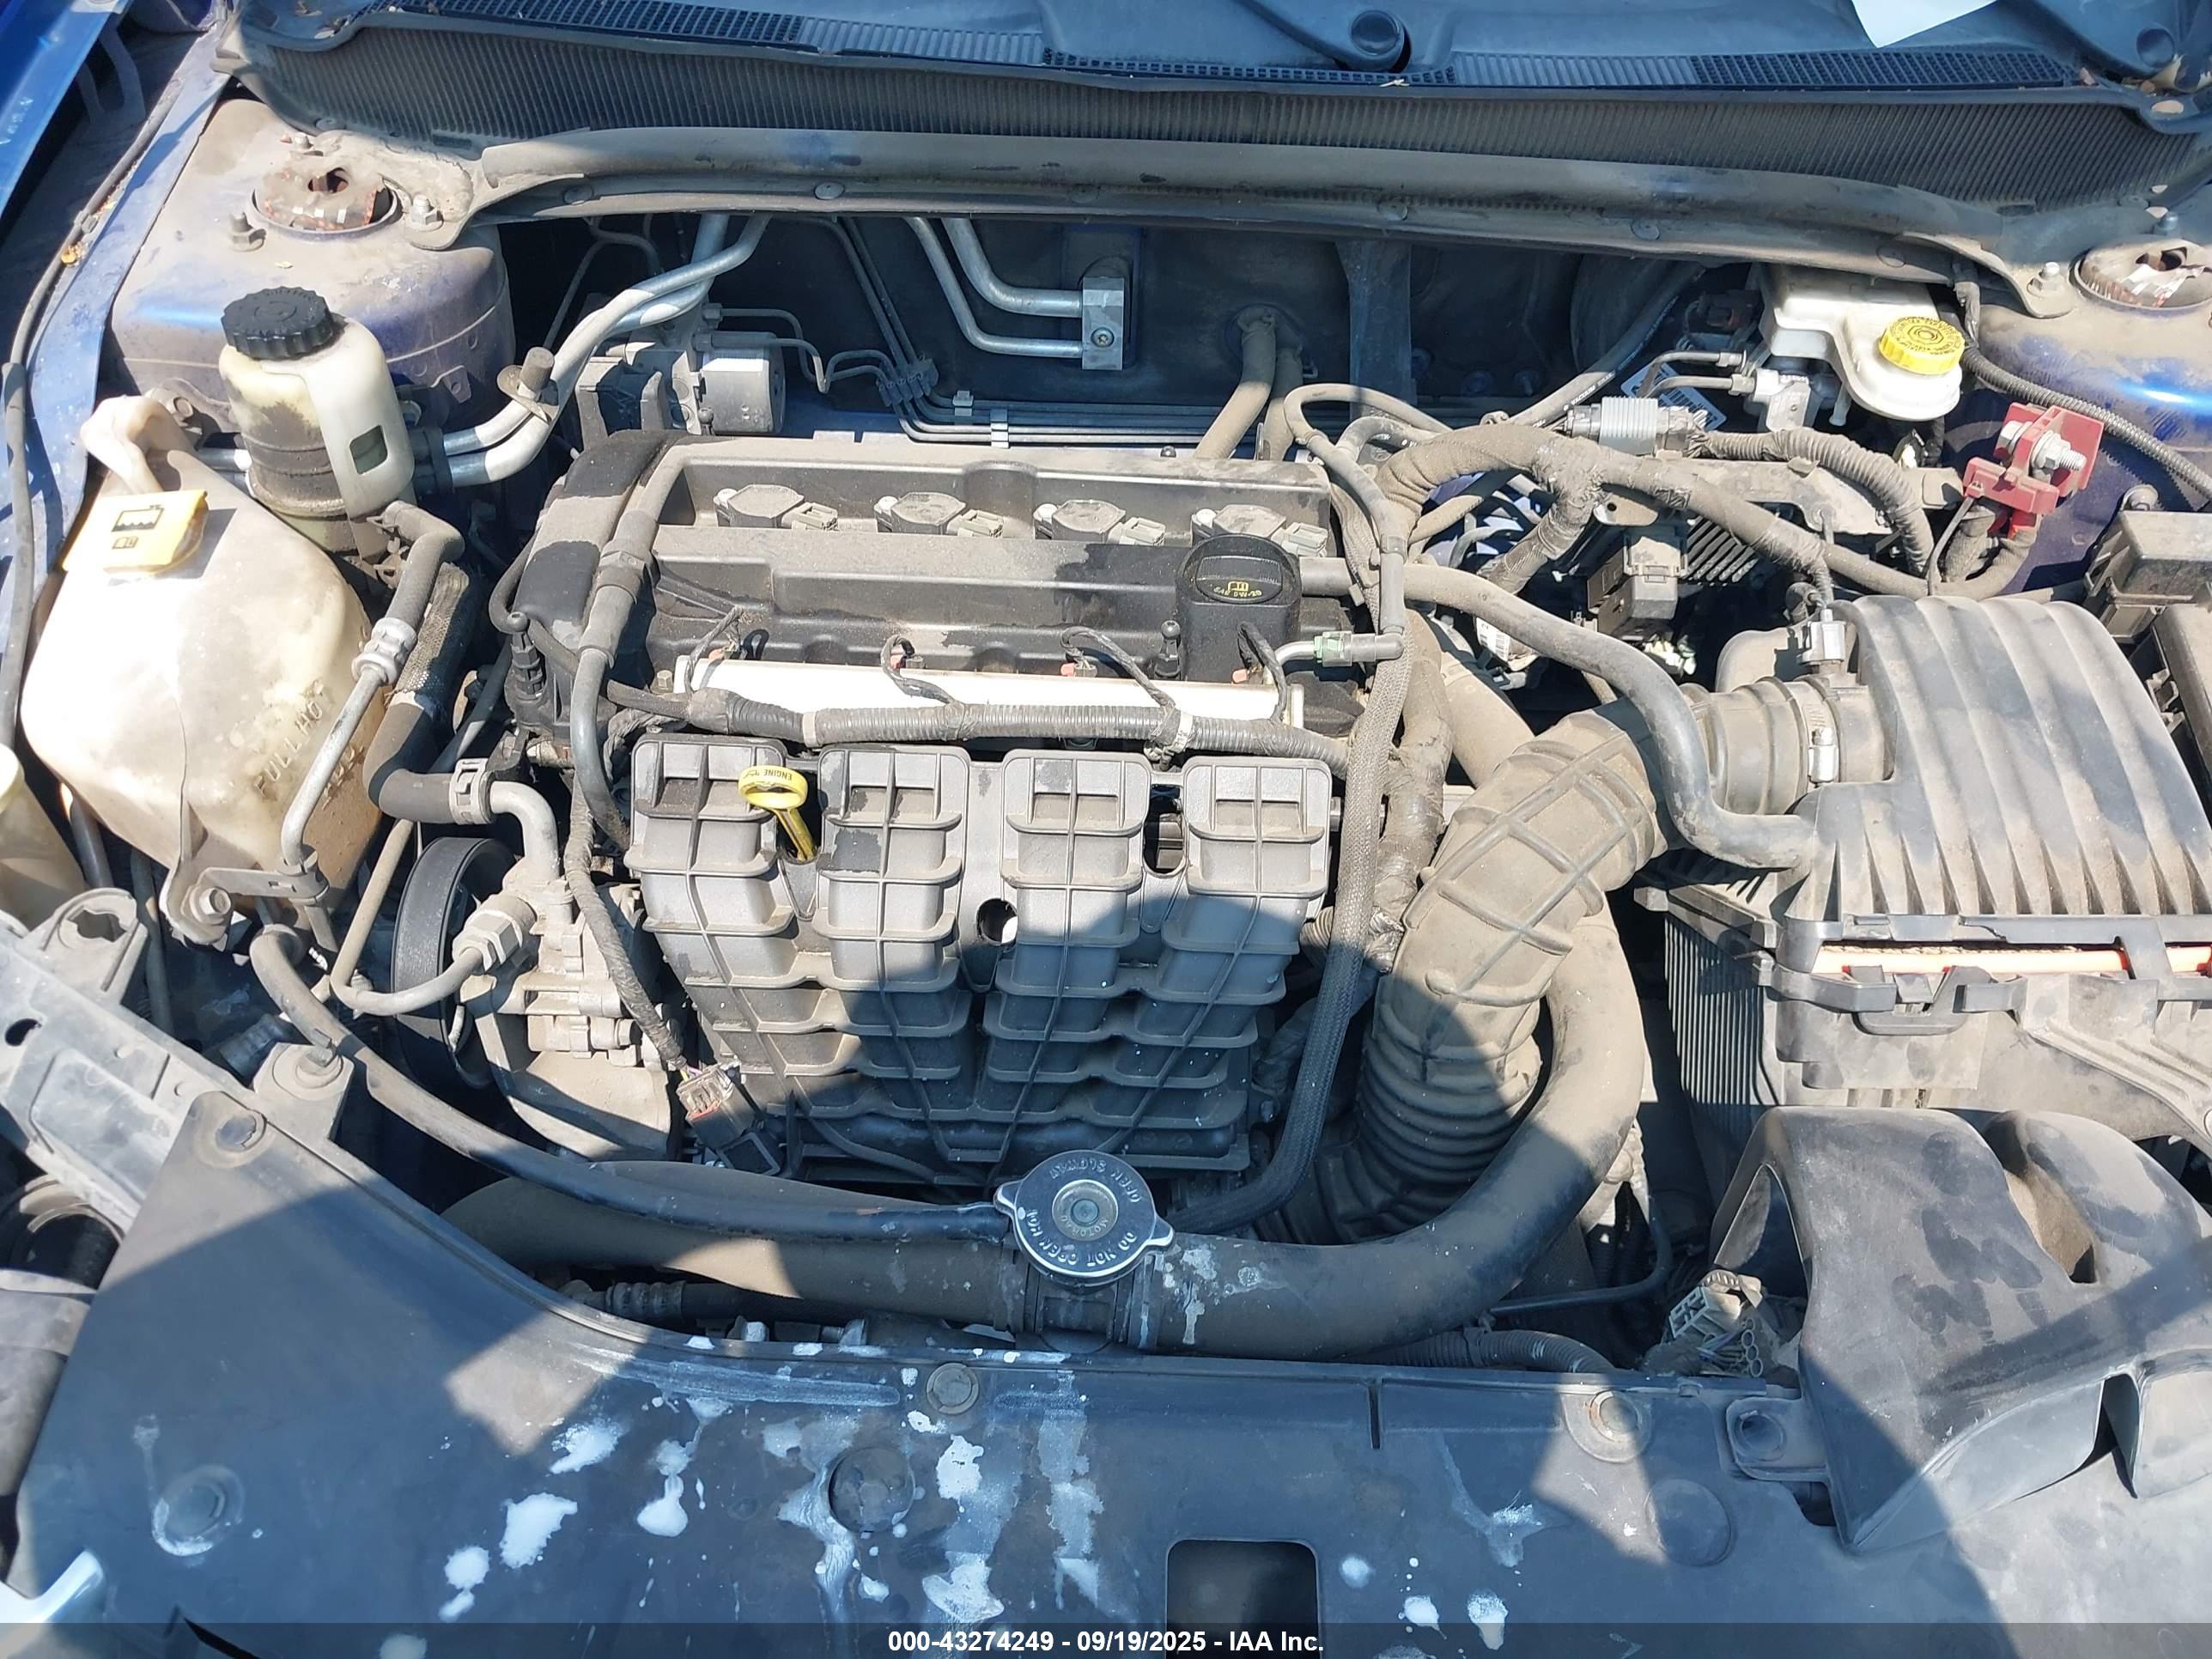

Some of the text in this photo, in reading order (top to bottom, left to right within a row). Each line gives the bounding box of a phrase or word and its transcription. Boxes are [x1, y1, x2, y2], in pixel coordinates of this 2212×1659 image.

[1213, 586, 1231, 596] SAE
[254, 737, 303, 799] FULL
[763, 769, 793, 781] ENGINE
[1111, 1169, 1141, 1203] OPEN
[1118, 1230, 1138, 1251] DO
[1038, 1237, 1079, 1266] OPEN
[1086, 1249, 1116, 1267] NOT
